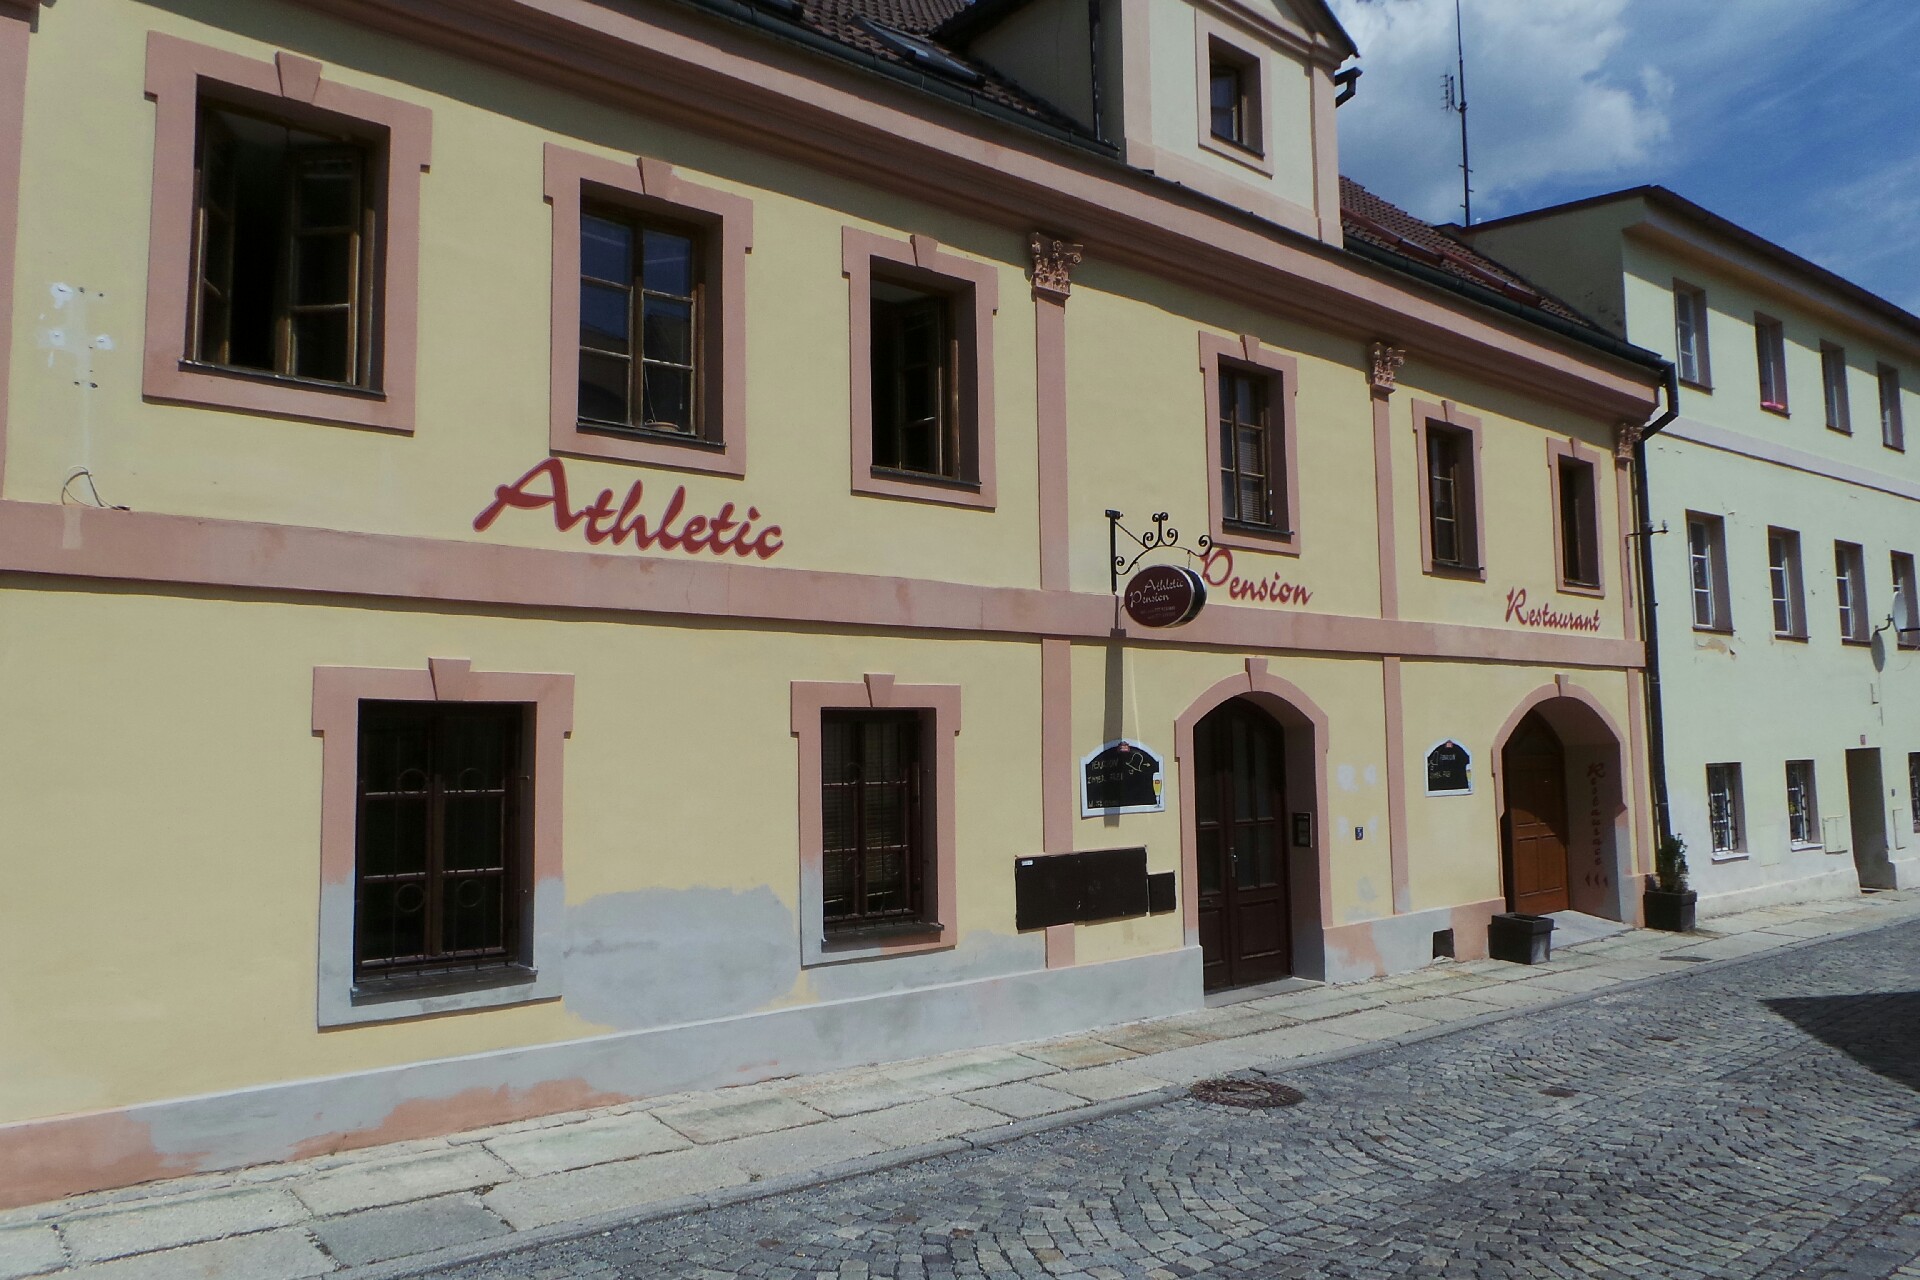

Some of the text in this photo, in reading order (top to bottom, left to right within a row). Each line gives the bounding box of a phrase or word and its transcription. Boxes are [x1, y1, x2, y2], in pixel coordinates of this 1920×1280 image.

[473, 456, 784, 560] Athletic
[1129, 590, 1170, 608] Pension
[1143, 577, 1185, 594] Athletic
[1200, 548, 1313, 606] Pension
[1505, 586, 1600, 632] Restaurant
